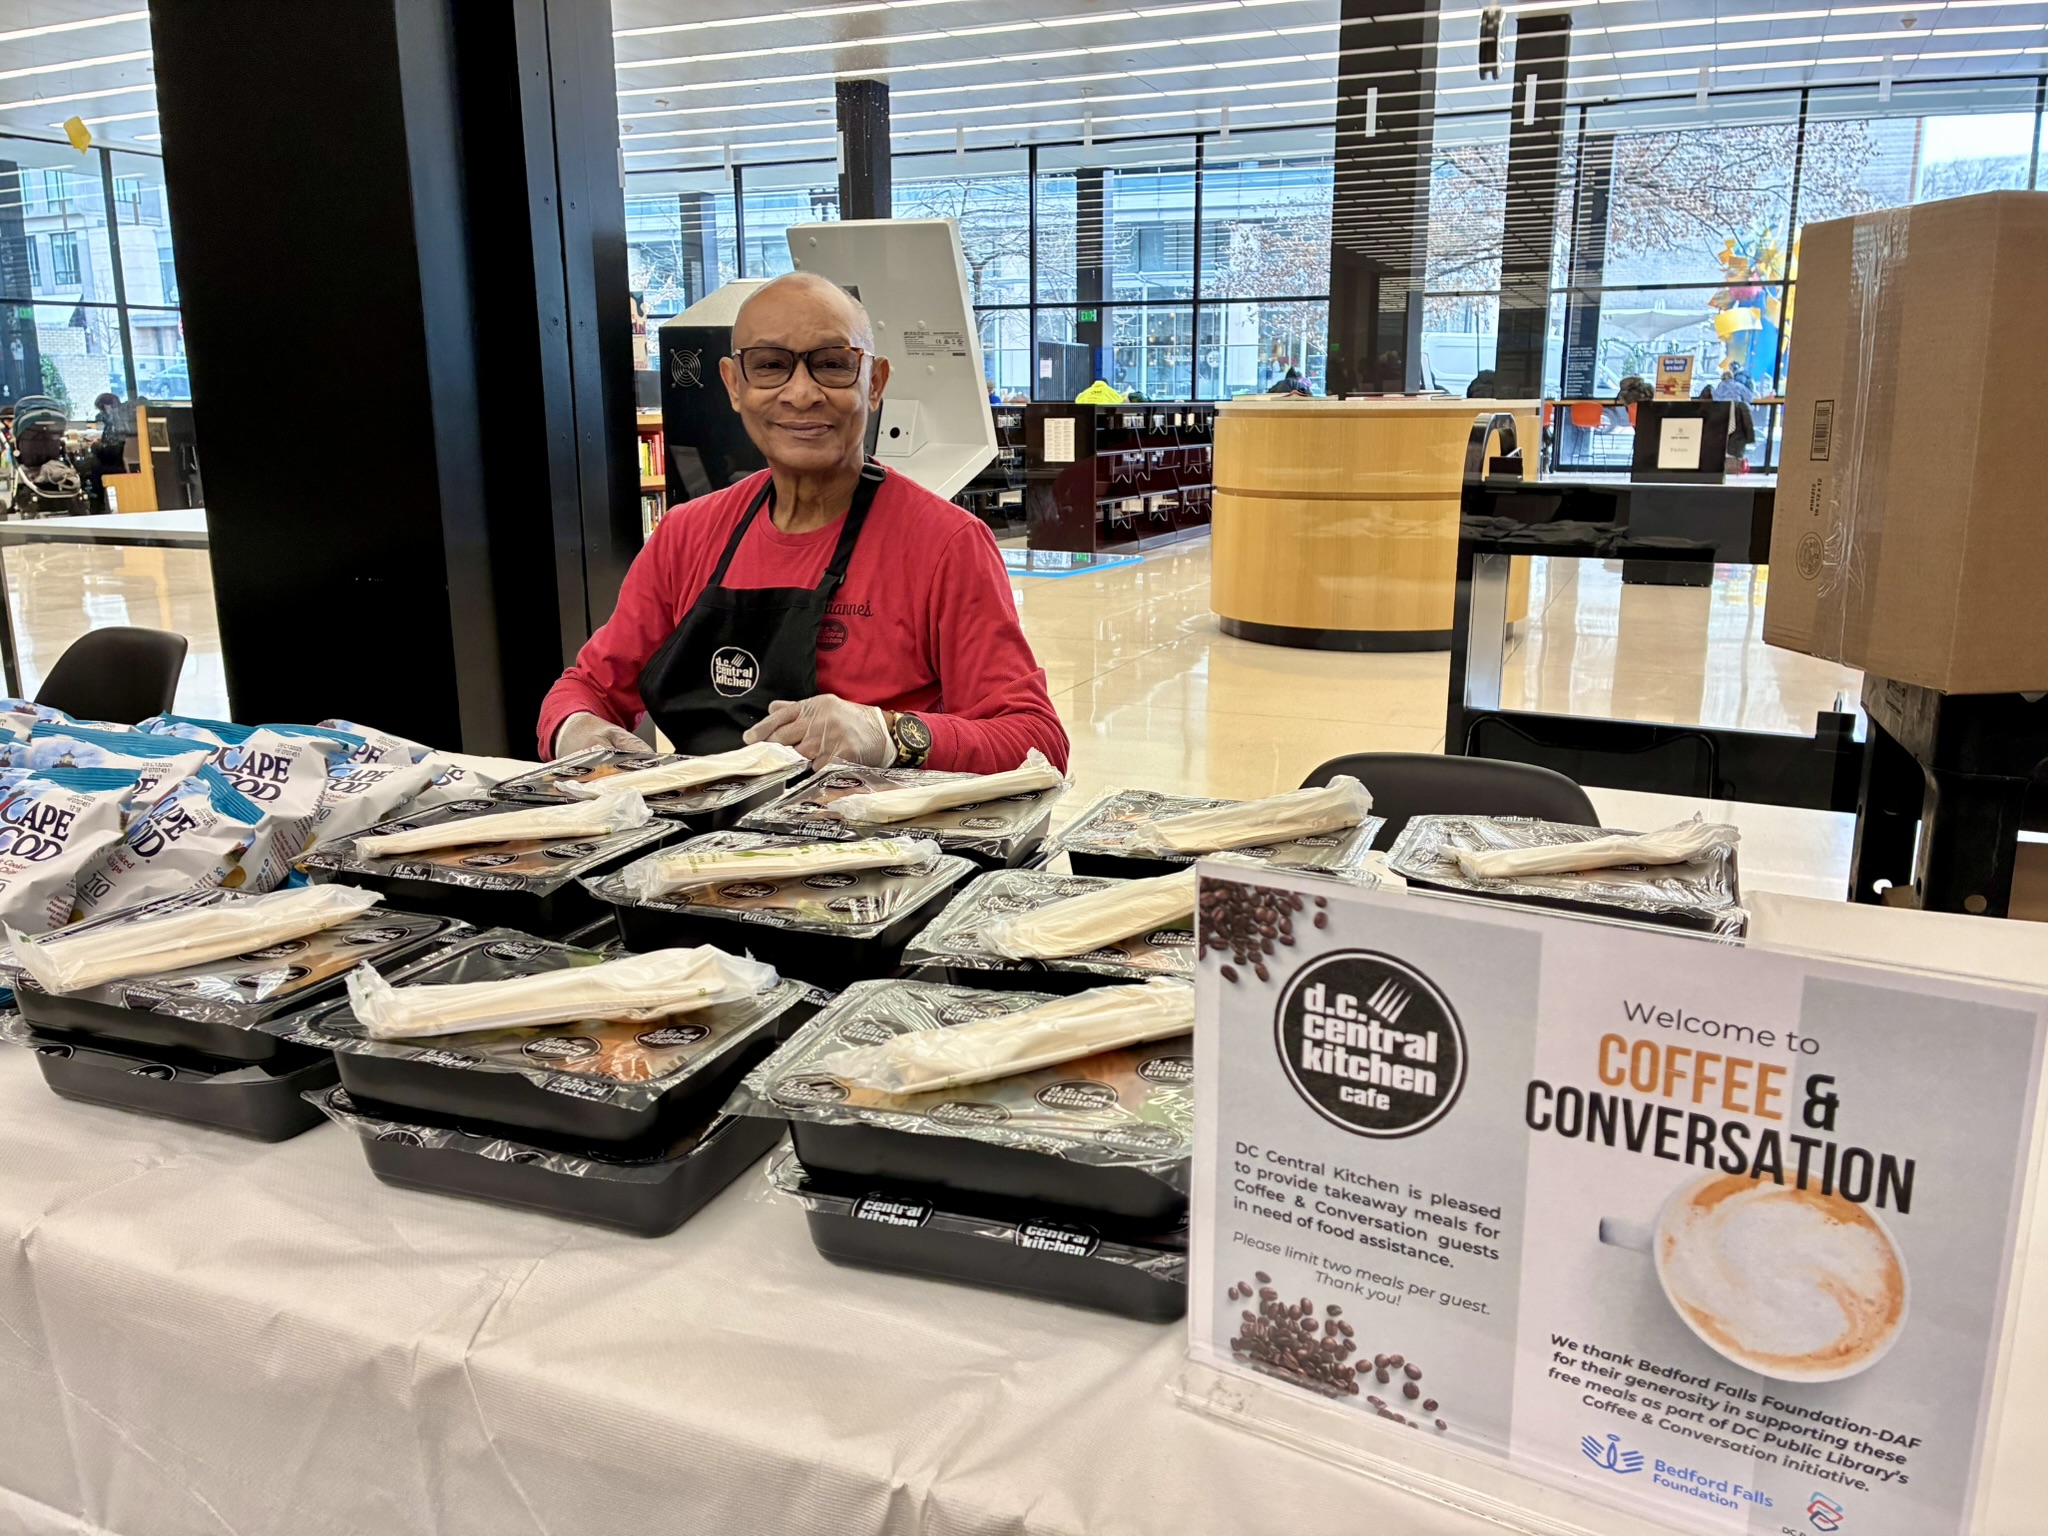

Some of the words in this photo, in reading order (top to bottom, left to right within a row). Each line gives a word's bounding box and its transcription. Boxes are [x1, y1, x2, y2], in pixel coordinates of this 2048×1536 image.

[716, 656, 731, 667] d.c.
[716, 666, 752, 678] central
[716, 674, 752, 688] kitchen
[218, 746, 291, 784] CAPE
[328, 768, 394, 783] CAPE
[1, 798, 76, 842] CAPE
[802, 828, 838, 839] kitchen
[806, 822, 842, 832] central
[0, 826, 63, 862] COD
[396, 864, 411, 874] d.c.
[636, 900, 677, 910] kitchen
[742, 912, 786, 926] kitchen
[1303, 982, 1368, 1022] d.c.
[1303, 1013, 1438, 1063] central
[1623, 1000, 1776, 1047] Welcome
[1786, 1031, 1820, 1055] to
[526, 1044, 581, 1057] kitchen
[538, 1040, 591, 1054] central
[1144, 1070, 1194, 1079] kitche
[1302, 1038, 1437, 1097] kitchen
[1598, 1032, 1788, 1121] COFFEE
[1802, 1073, 1840, 1133] &
[1042, 1094, 1103, 1108] kitchen
[1339, 1085, 1391, 1111] cafe
[1525, 1079, 1917, 1215] CONVERSATION
[1235, 1141, 1259, 1158] DC
[1266, 1150, 1325, 1176] Central
[1334, 1167, 1400, 1195] Kitchen
[1409, 1184, 1422, 1200] is
[1431, 1193, 1501, 1221] pleased
[862, 1200, 924, 1218] central
[1234, 1161, 1251, 1175] to
[1257, 1168, 1318, 1193] provide
[1325, 1184, 1407, 1218] takeaway
[1415, 1208, 1468, 1232] meals
[1475, 1221, 1501, 1240] for
[858, 1210, 918, 1228] kitchen
[1026, 1226, 1090, 1245] central
[1234, 1179, 1285, 1203] Coffee
[1294, 1195, 1306, 1209] &
[1315, 1201, 1427, 1241] Conversation
[1438, 1235, 1499, 1260] guests
[1234, 1196, 1248, 1211] in
[1252, 1203, 1292, 1224] need
[1297, 1215, 1315, 1229] of
[1316, 1219, 1355, 1241] food
[1359, 1232, 1455, 1268] assistance.
[1022, 1237, 1086, 1257] kitchen
[1233, 1231, 1281, 1255] Please
[1285, 1245, 1318, 1266] limit
[1323, 1258, 1352, 1275] two
[1356, 1268, 1404, 1290] meals
[1407, 1282, 1437, 1300] per
[1440, 1292, 1491, 1316] guest.
[1316, 1271, 1364, 1295] Thank
[1366, 1288, 1402, 1307] you!
[1550, 1333, 1578, 1352] We
[1583, 1343, 1634, 1369] thank
[1638, 1360, 1709, 1390] Bedford
[1714, 1381, 1758, 1404] Falls
[1762, 1395, 1922, 1450] Foundation-DAF
[1553, 1351, 1577, 1368] for
[1581, 1358, 1623, 1380] their
[1625, 1374, 1720, 1412] generosity
[1725, 1401, 1741, 1416] in
[1745, 1409, 1849, 1450] supporting
[1853, 1440, 1907, 1465] these
[1548, 1367, 1581, 1386] free
[1585, 1380, 1637, 1402] meals
[1642, 1395, 1662, 1411] as
[1666, 1403, 1704, 1425] part
[1709, 1414, 1730, 1430] of
[1732, 1423, 1760, 1440] DC
[1763, 1433, 1822, 1460] Public
[1826, 1451, 1909, 1485] Library's
[1582, 1394, 1637, 1420] Coffee
[1641, 1410, 1655, 1425] &
[1658, 1417, 1778, 1464] Conversation
[1782, 1455, 1870, 1492] initiative.
[1653, 1474, 1739, 1510] Foundation
[1654, 1459, 1728, 1493] Bedford
[1733, 1484, 1774, 1508] Falls
